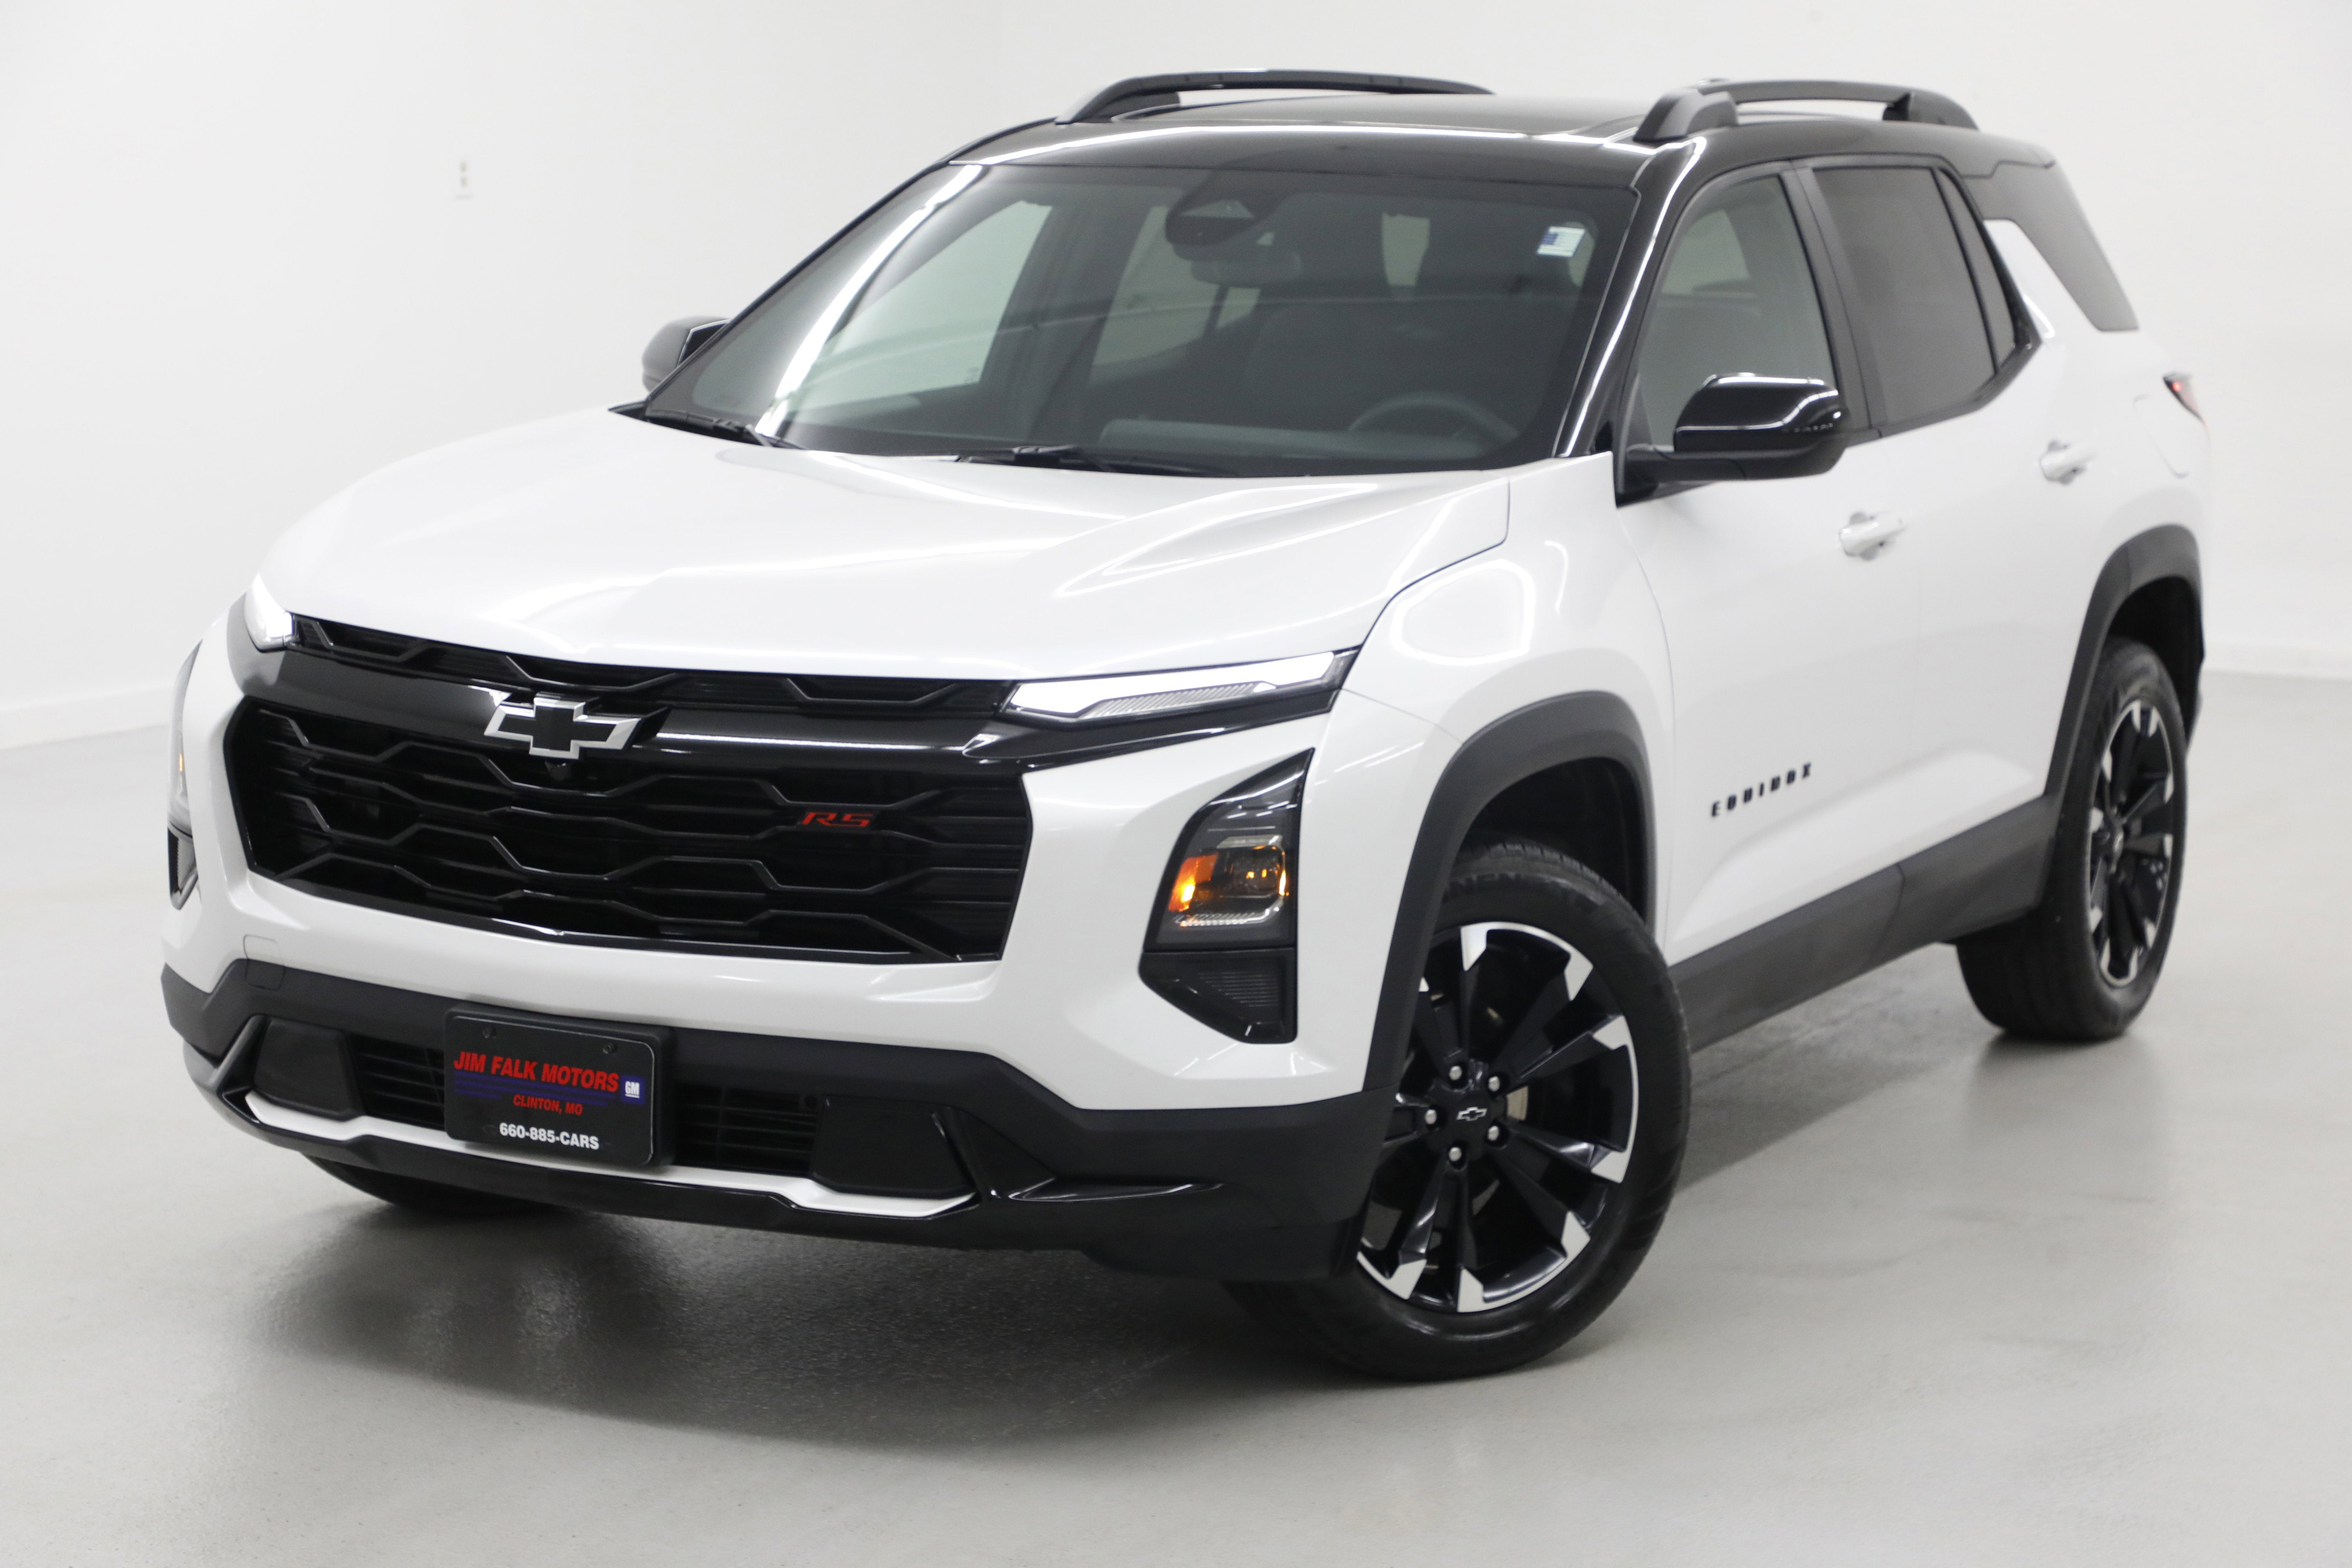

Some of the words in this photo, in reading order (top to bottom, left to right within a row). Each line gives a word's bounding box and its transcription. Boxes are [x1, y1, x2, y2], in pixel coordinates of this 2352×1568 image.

[1710, 762, 1812, 817] EQUINOX
[801, 812, 873, 827] RS
[453, 1051, 487, 1073] JIM
[490, 1056, 538, 1080] FALK
[541, 1063, 620, 1093] MOTORS
[625, 1081, 640, 1096] GM
[513, 1094, 563, 1115] CLINTON,
[565, 1102, 584, 1116] MO
[499, 1122, 599, 1150] 660-885-CARS
